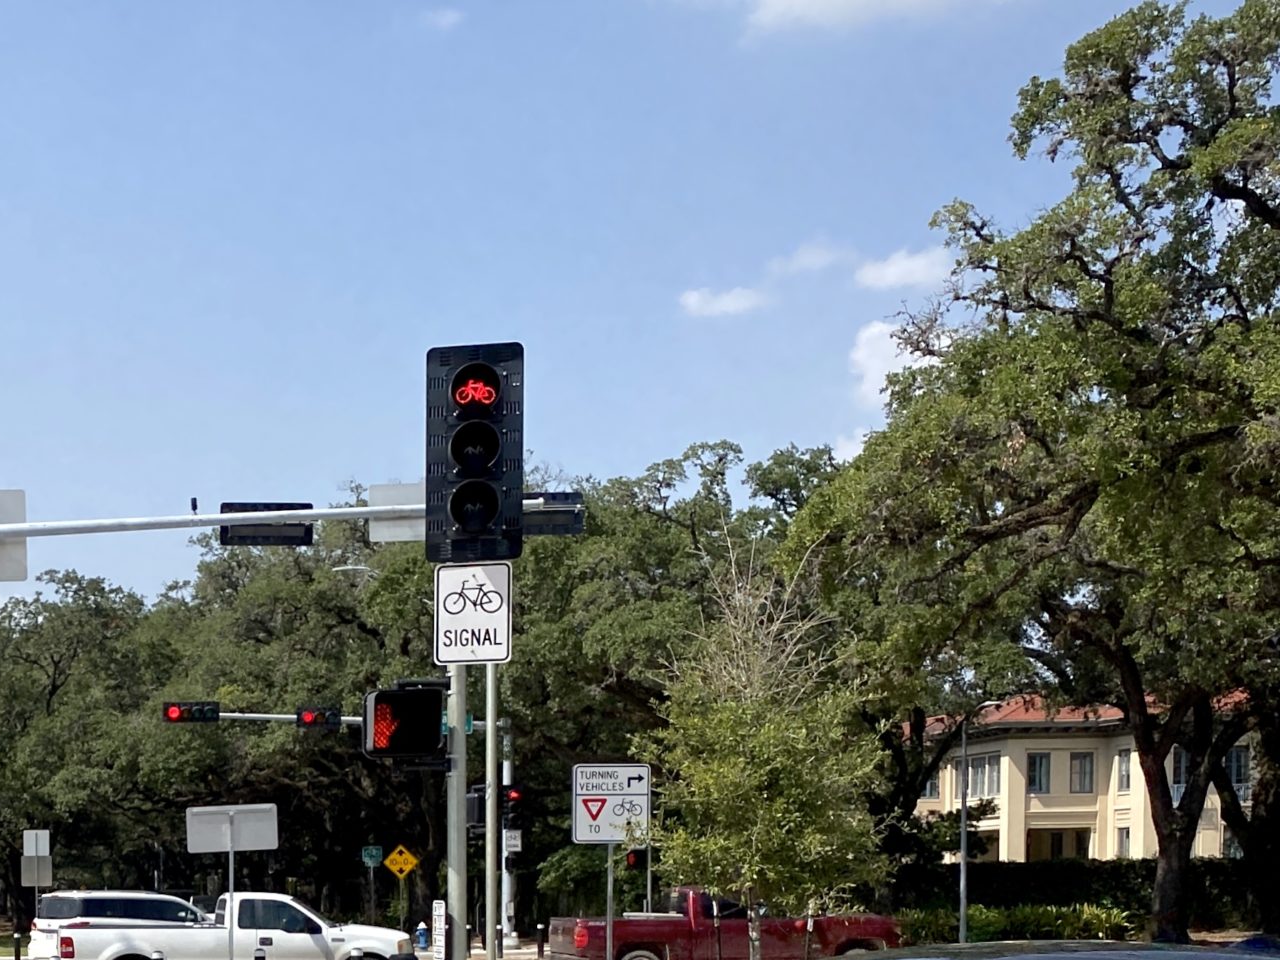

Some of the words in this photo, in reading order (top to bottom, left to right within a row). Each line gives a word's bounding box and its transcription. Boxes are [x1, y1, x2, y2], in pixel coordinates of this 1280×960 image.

[443, 628, 503, 647] SIGNAL
[580, 771, 618, 780] TURNING
[579, 782, 625, 791] VEHICLES
[589, 825, 600, 833] TO
